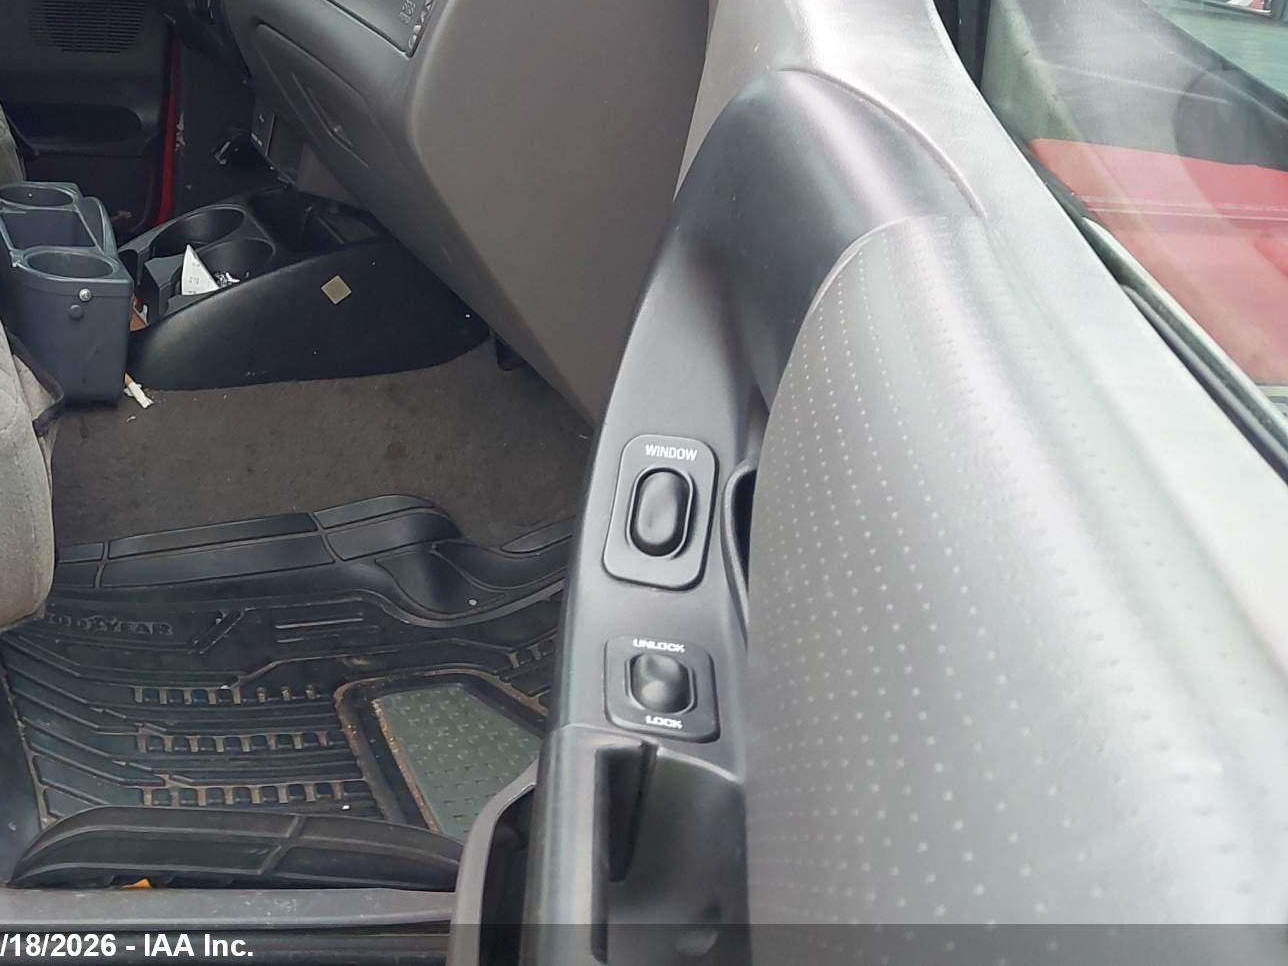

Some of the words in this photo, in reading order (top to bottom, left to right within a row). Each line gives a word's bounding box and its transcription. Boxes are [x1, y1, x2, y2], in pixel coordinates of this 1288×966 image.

[645, 444, 698, 462] WINDOW
[632, 638, 686, 653] UNLOCK
[645, 715, 683, 729] LOCK
